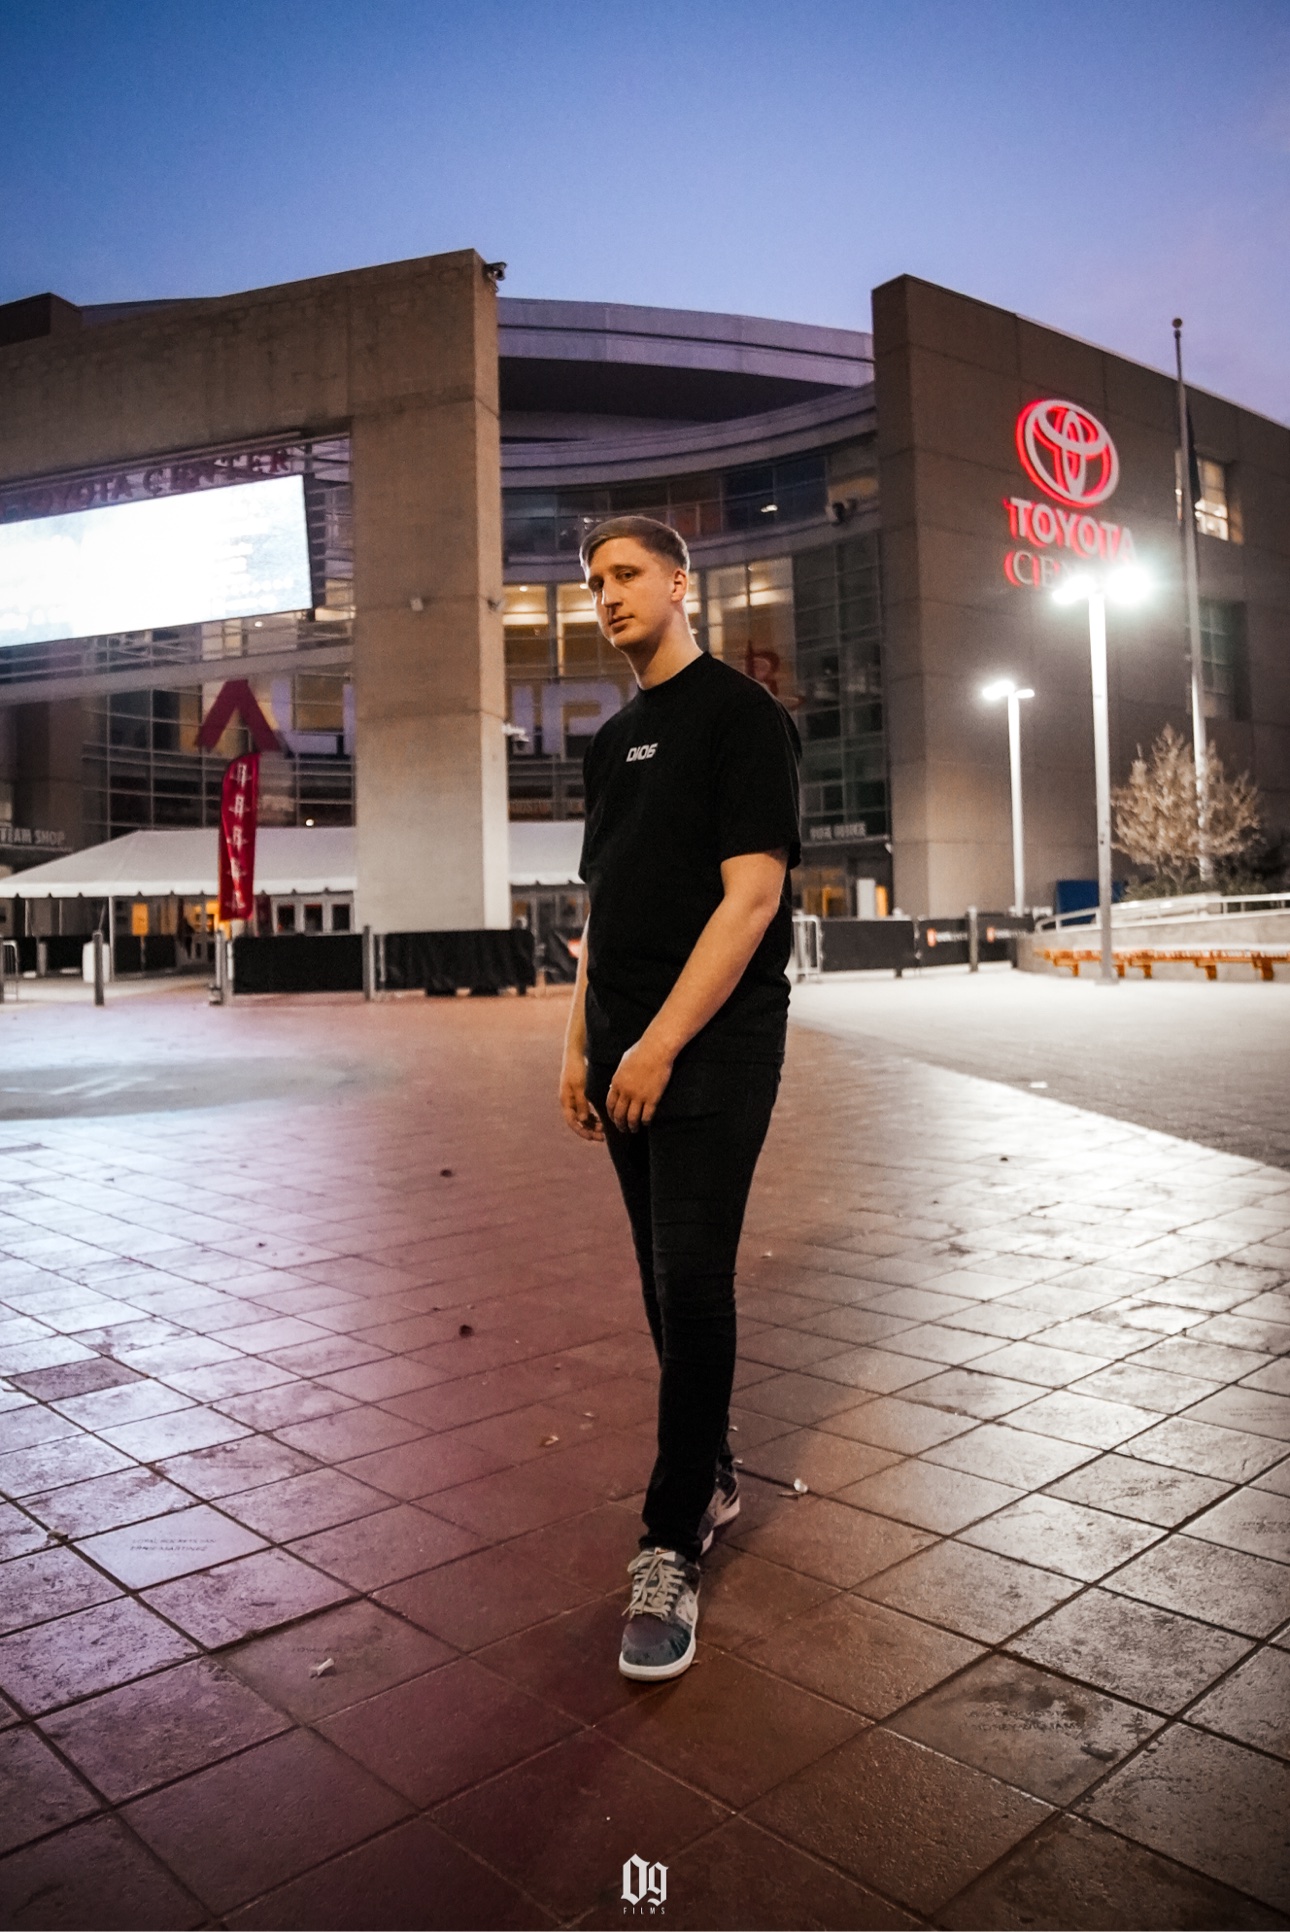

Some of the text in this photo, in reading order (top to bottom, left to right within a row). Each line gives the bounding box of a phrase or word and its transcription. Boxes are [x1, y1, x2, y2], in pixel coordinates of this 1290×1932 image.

[1004, 496, 1138, 562] TOYOTA
[0, 828, 65, 846] TEAM SHOP
